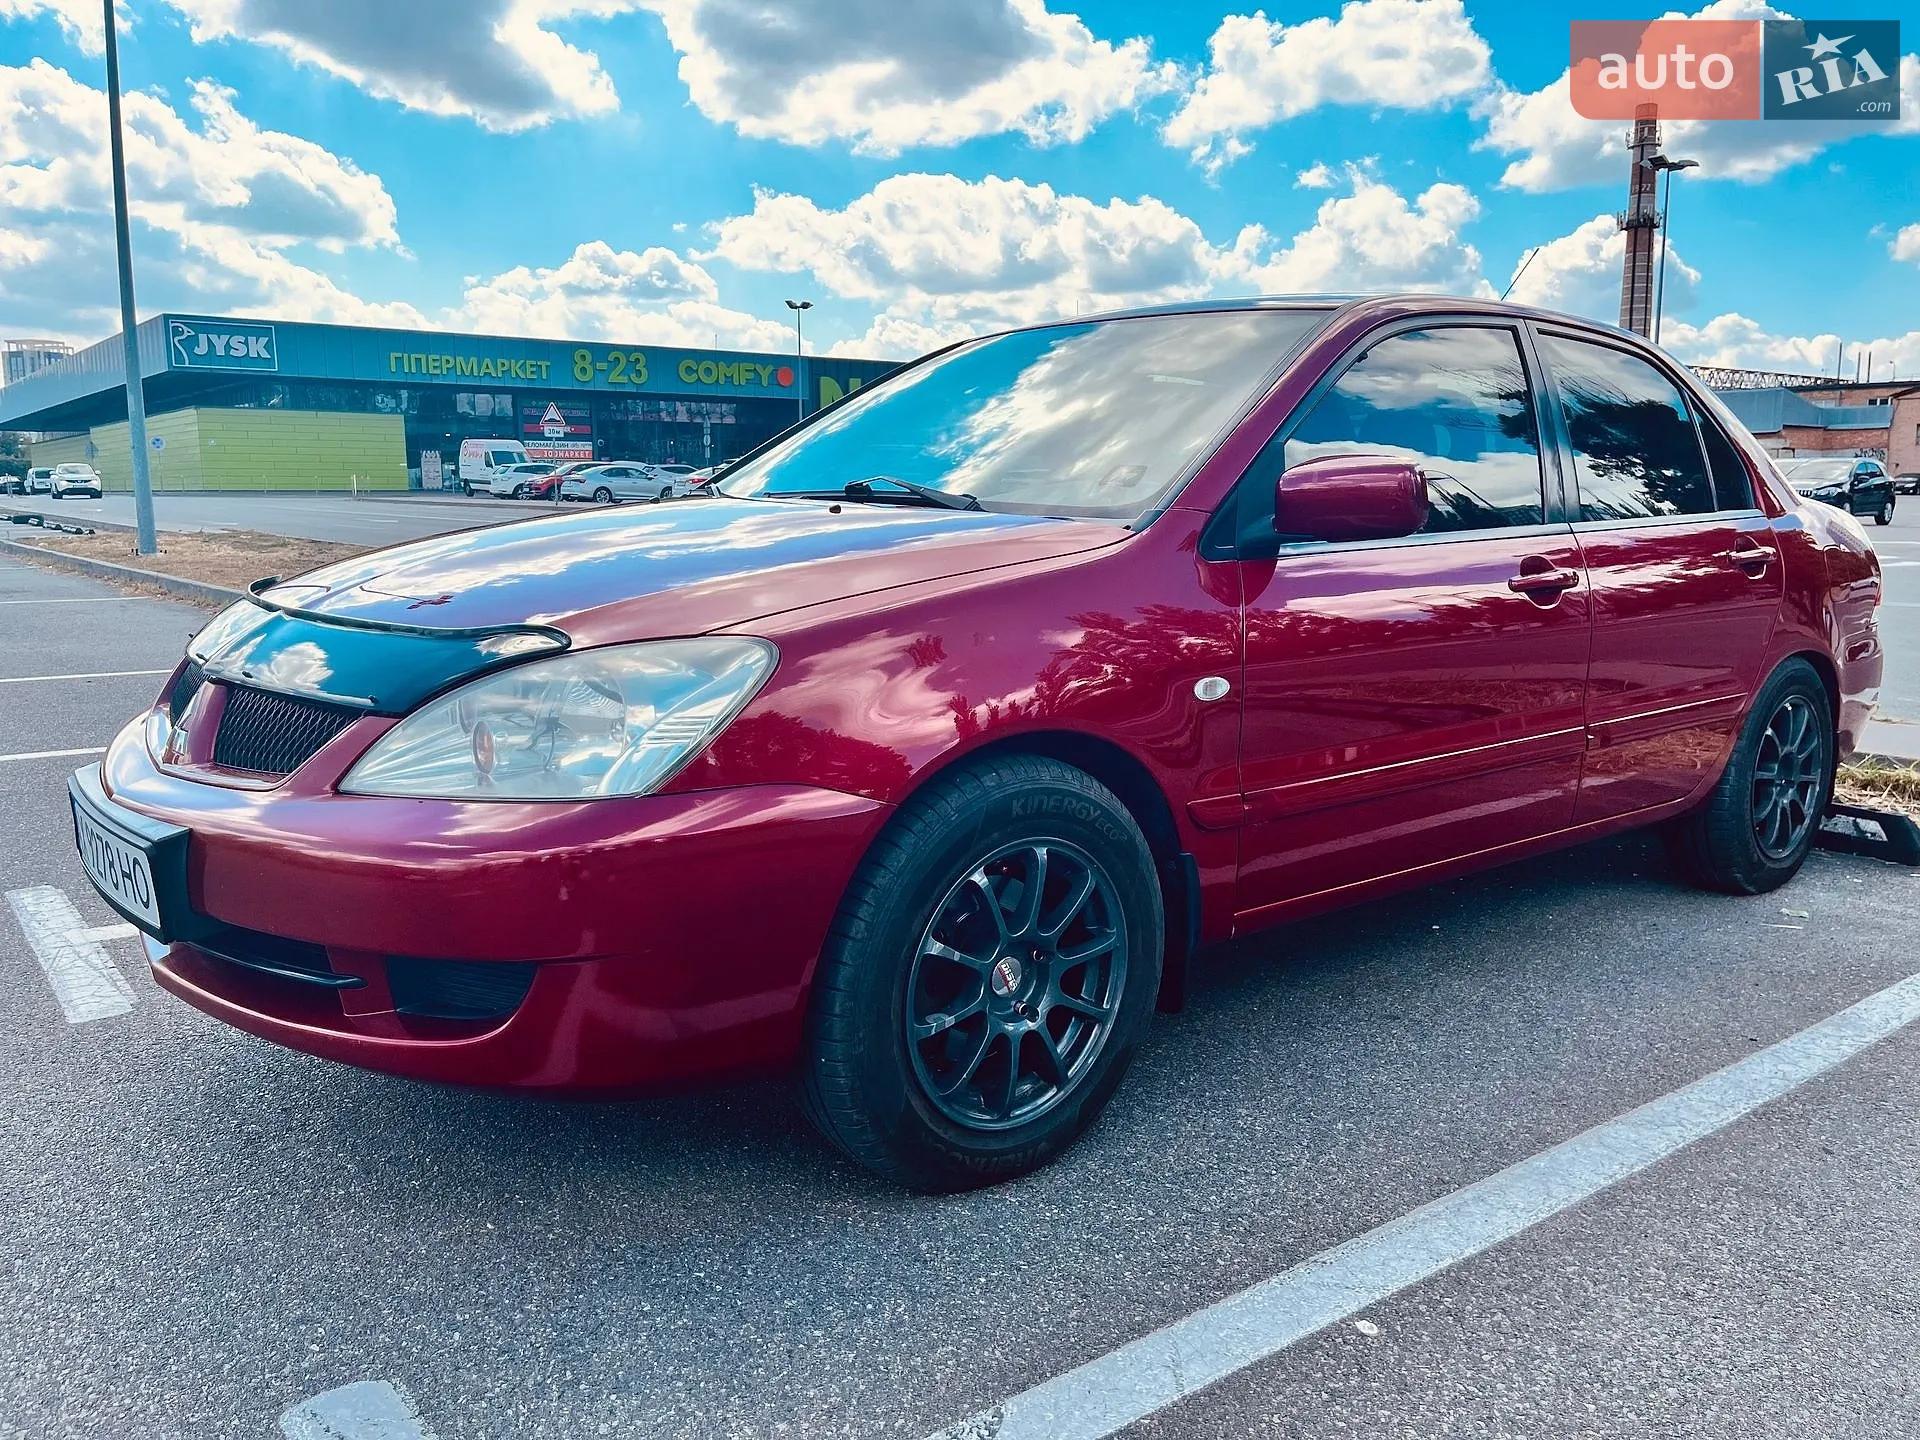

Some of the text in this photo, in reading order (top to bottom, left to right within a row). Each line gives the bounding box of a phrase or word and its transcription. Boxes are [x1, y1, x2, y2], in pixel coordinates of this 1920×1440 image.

[193, 333, 271, 359] JYSK
[389, 352, 550, 379] ГІПЕРМАРКЕТ
[573, 349, 649, 384] 8-23
[678, 359, 774, 387] COMFY
